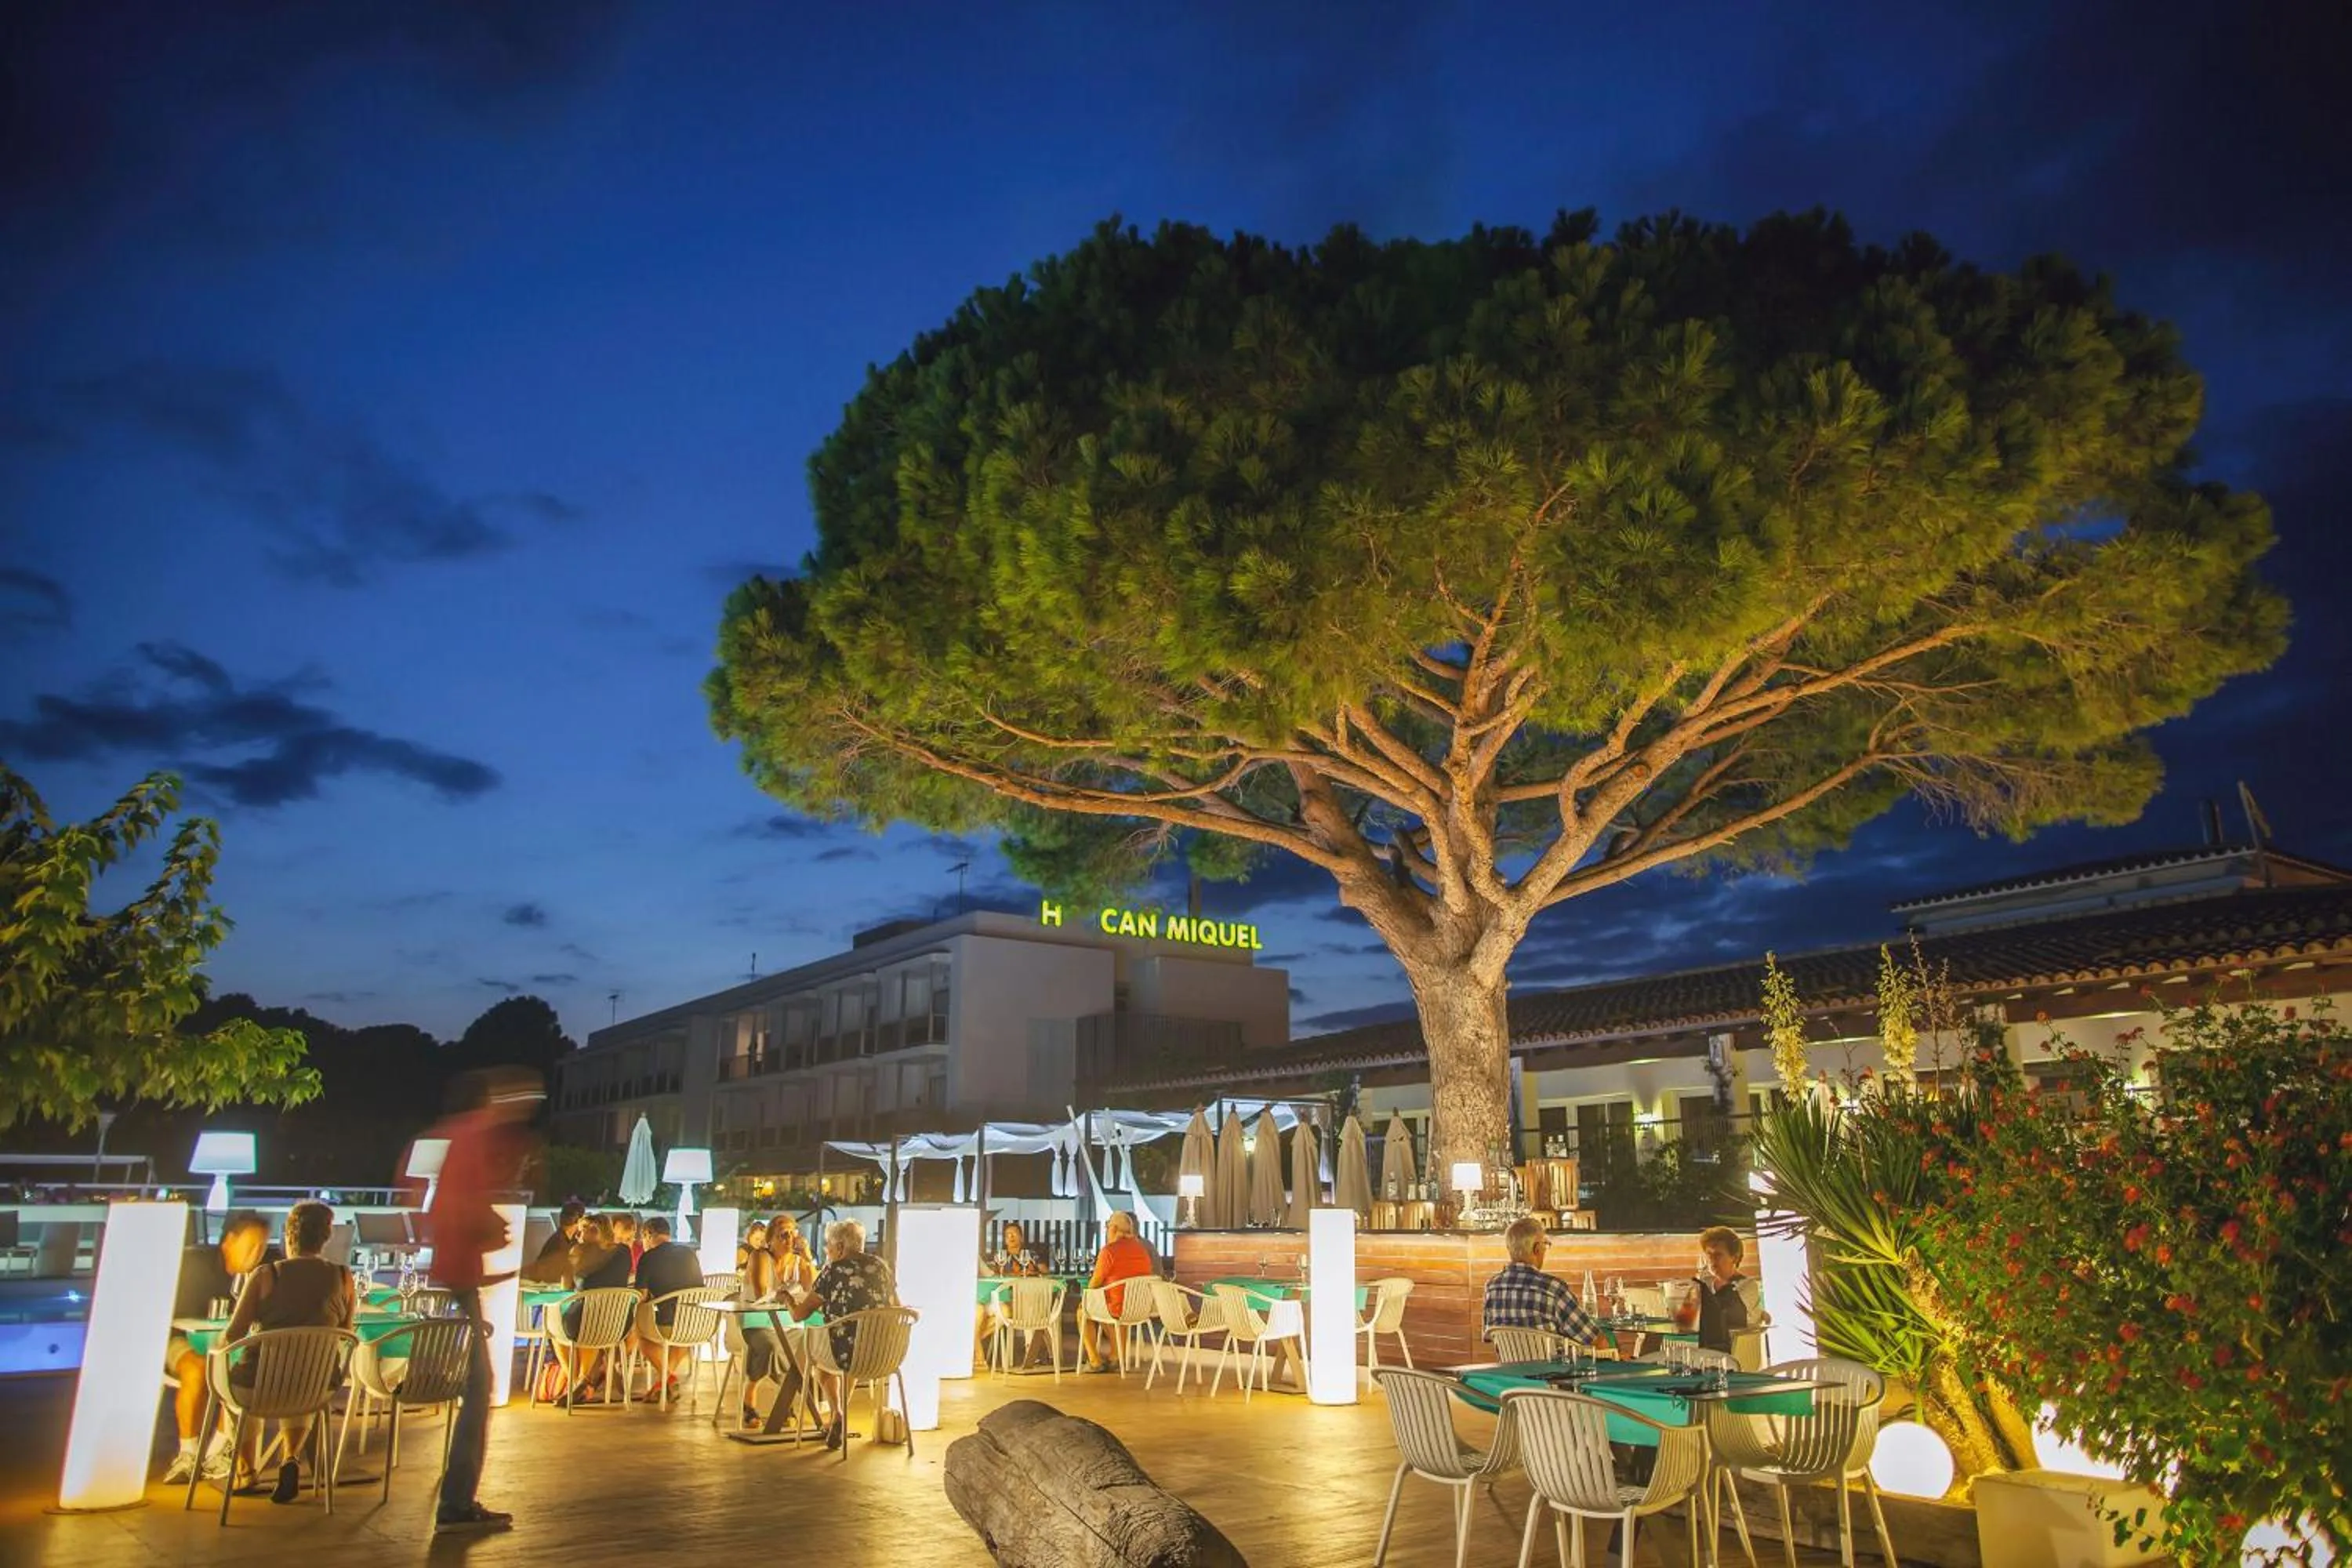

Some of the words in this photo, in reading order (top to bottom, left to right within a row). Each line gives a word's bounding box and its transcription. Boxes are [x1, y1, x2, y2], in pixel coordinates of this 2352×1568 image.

[1041, 900, 1062, 927] H
[1100, 908, 1157, 938] CAN
[1166, 915, 1264, 950] MIQUEL
